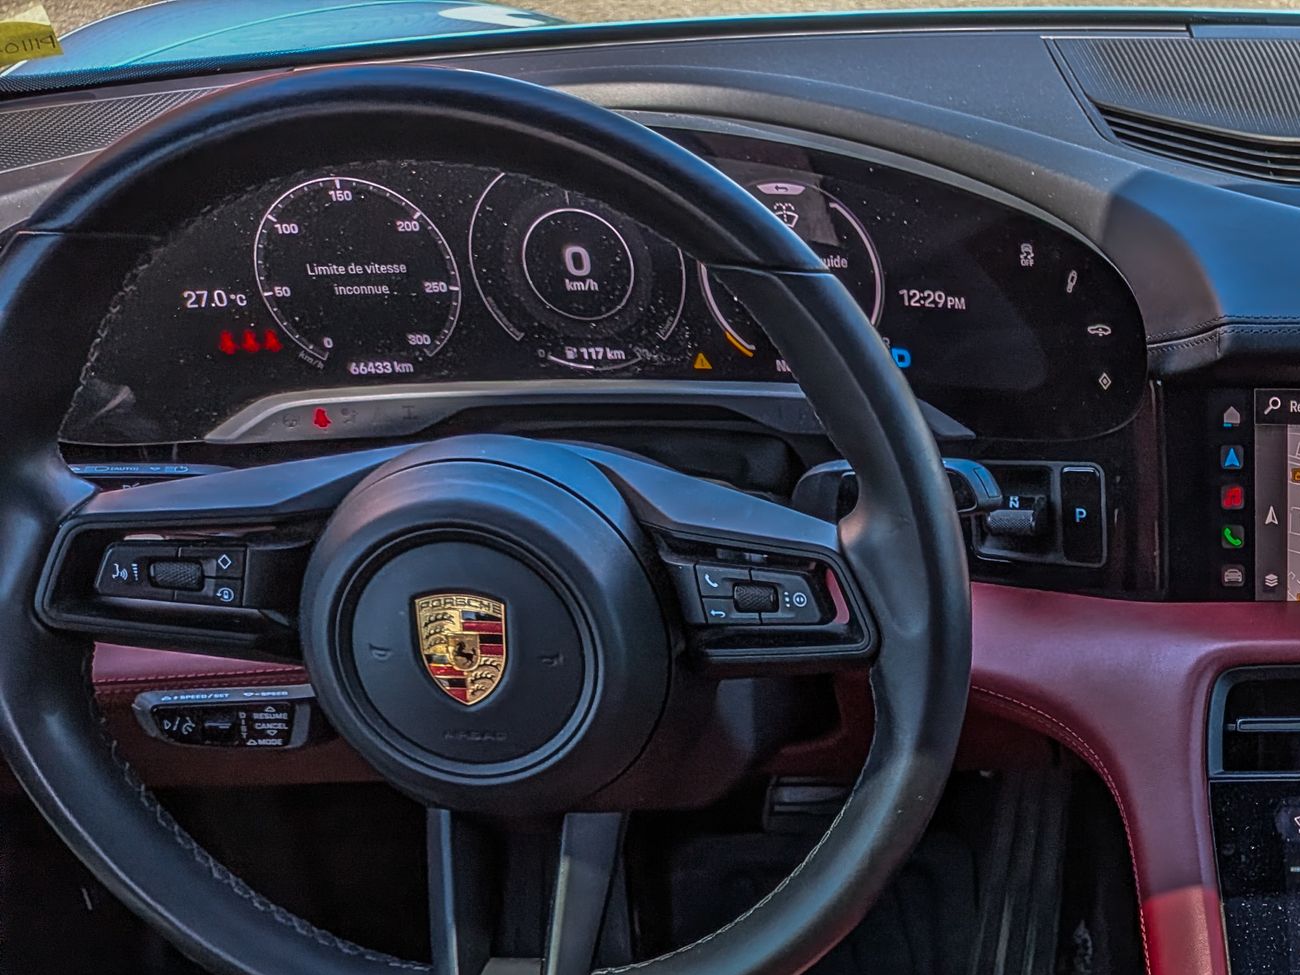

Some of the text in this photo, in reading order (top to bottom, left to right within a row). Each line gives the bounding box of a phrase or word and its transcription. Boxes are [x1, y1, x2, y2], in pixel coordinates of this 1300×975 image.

[329, 190, 352, 202] 150
[274, 223, 299, 235] 100
[396, 221, 420, 232] 200
[564, 246, 591, 276] 0
[823, 256, 848, 269] uide
[306, 262, 408, 276] Limite de vitesse
[274, 286, 291, 297] 50
[334, 283, 390, 296] inconnue
[424, 281, 448, 293] 250
[565, 278, 599, 292] km/h
[183, 289, 228, 309] 27.0
[899, 289, 966, 310] 12:29 PM
[323, 337, 334, 348] 0
[408, 334, 431, 345] 300
[580, 348, 604, 360] 117
[606, 347, 626, 360] km
[350, 360, 414, 375] 66433 km
[1075, 508, 1087, 522] P
[419, 597, 503, 614] PORSCHE
[252, 712, 289, 720] RESUME
[254, 722, 289, 730] CANCEL
[257, 738, 283, 746] MODE
